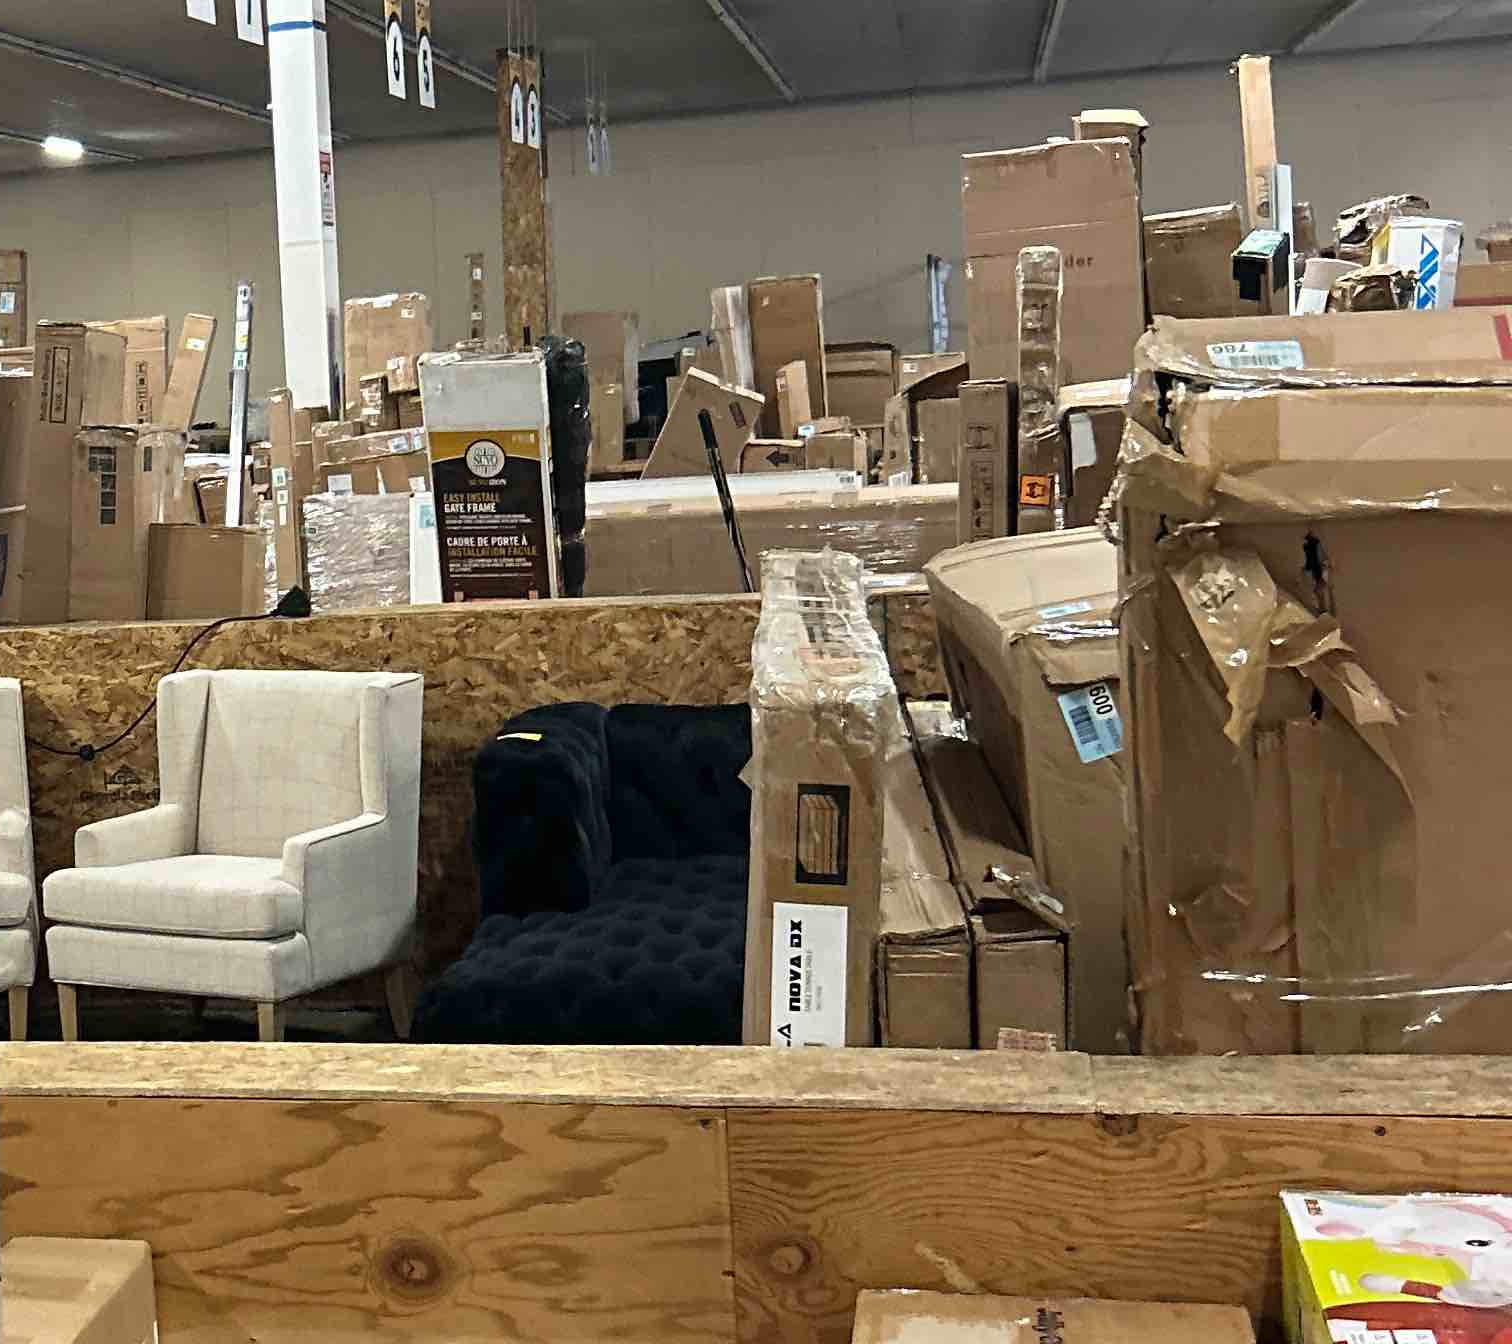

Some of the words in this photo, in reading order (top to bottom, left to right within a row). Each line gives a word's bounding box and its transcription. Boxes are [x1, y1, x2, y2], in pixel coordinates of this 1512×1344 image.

[392, 35, 401, 82] 6
[422, 49, 430, 93] 5
[1211, 342, 1248, 355] 786
[467, 493, 500, 503] INSTALL
[444, 503, 465, 513] GATE
[467, 503, 497, 513] FRAME
[446, 537, 475, 547] CADRE
[477, 537, 489, 546] DE
[491, 536, 519, 546] PORTE
[447, 546, 505, 556] INSTALLATION
[507, 545, 537, 555] FACILE
[1089, 685, 1114, 716] 600
[788, 918, 803, 950] DX
